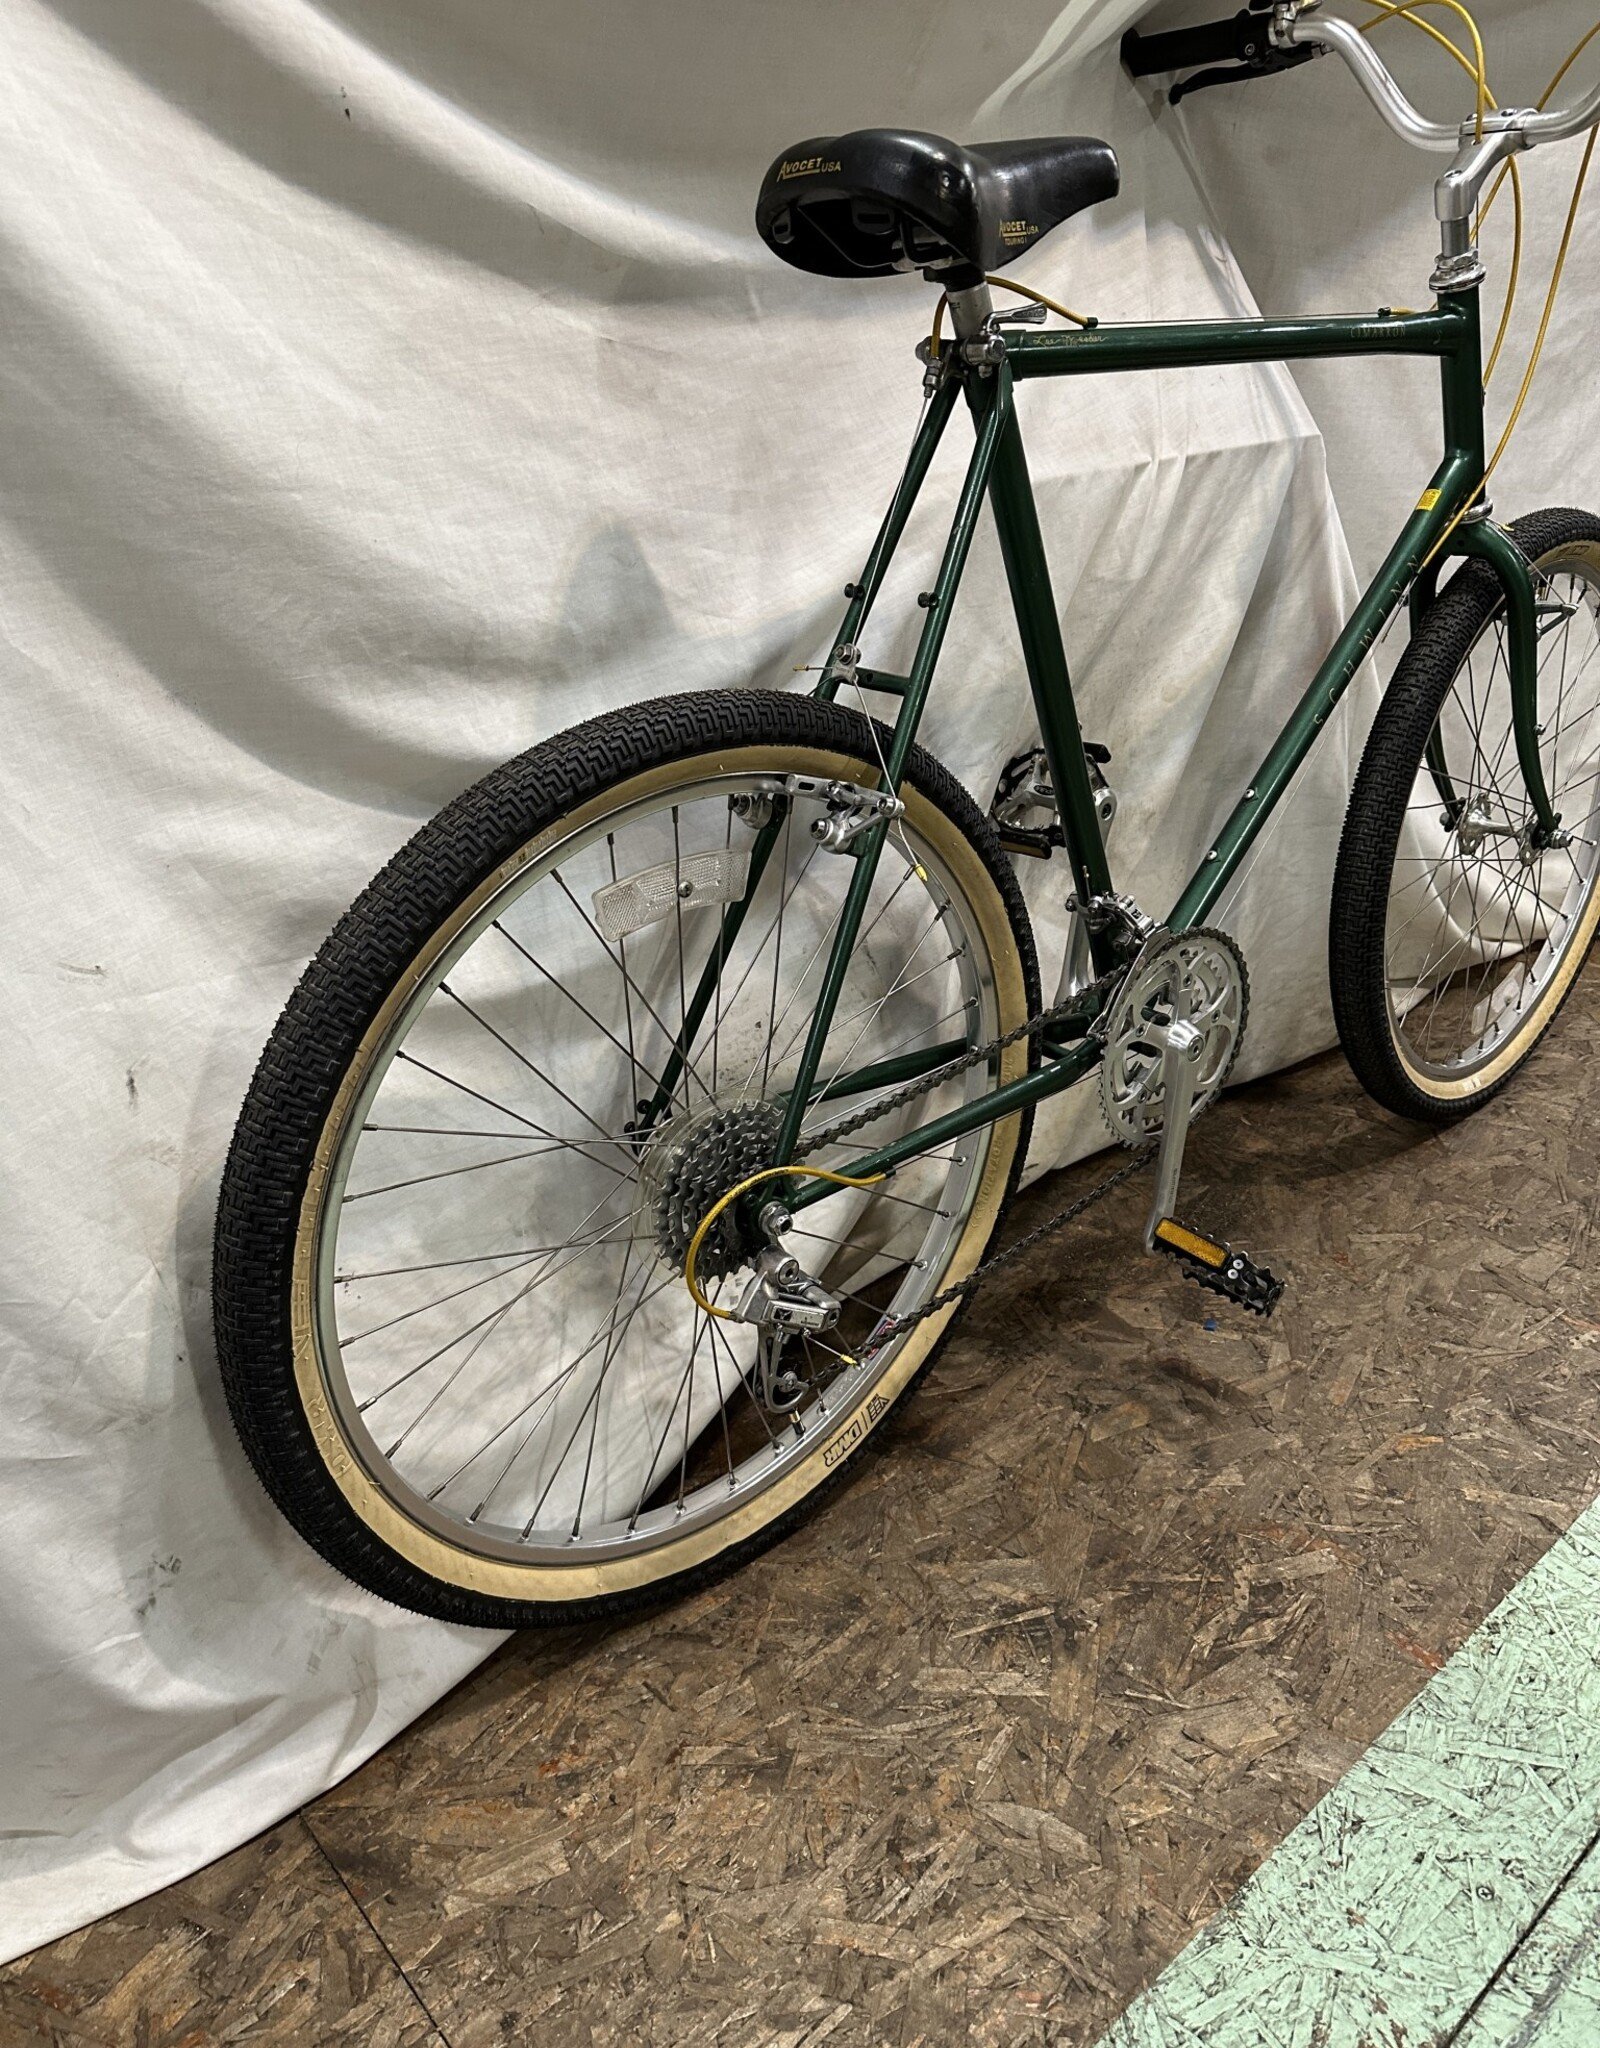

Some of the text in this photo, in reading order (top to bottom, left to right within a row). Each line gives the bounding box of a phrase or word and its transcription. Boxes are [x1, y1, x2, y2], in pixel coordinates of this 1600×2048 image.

[776, 157, 842, 182] AVOCET USA
[1026, 225, 1039, 235] USA
[1313, 554, 1419, 725] SCHWINN
[823, 1420, 862, 1467] DMR
